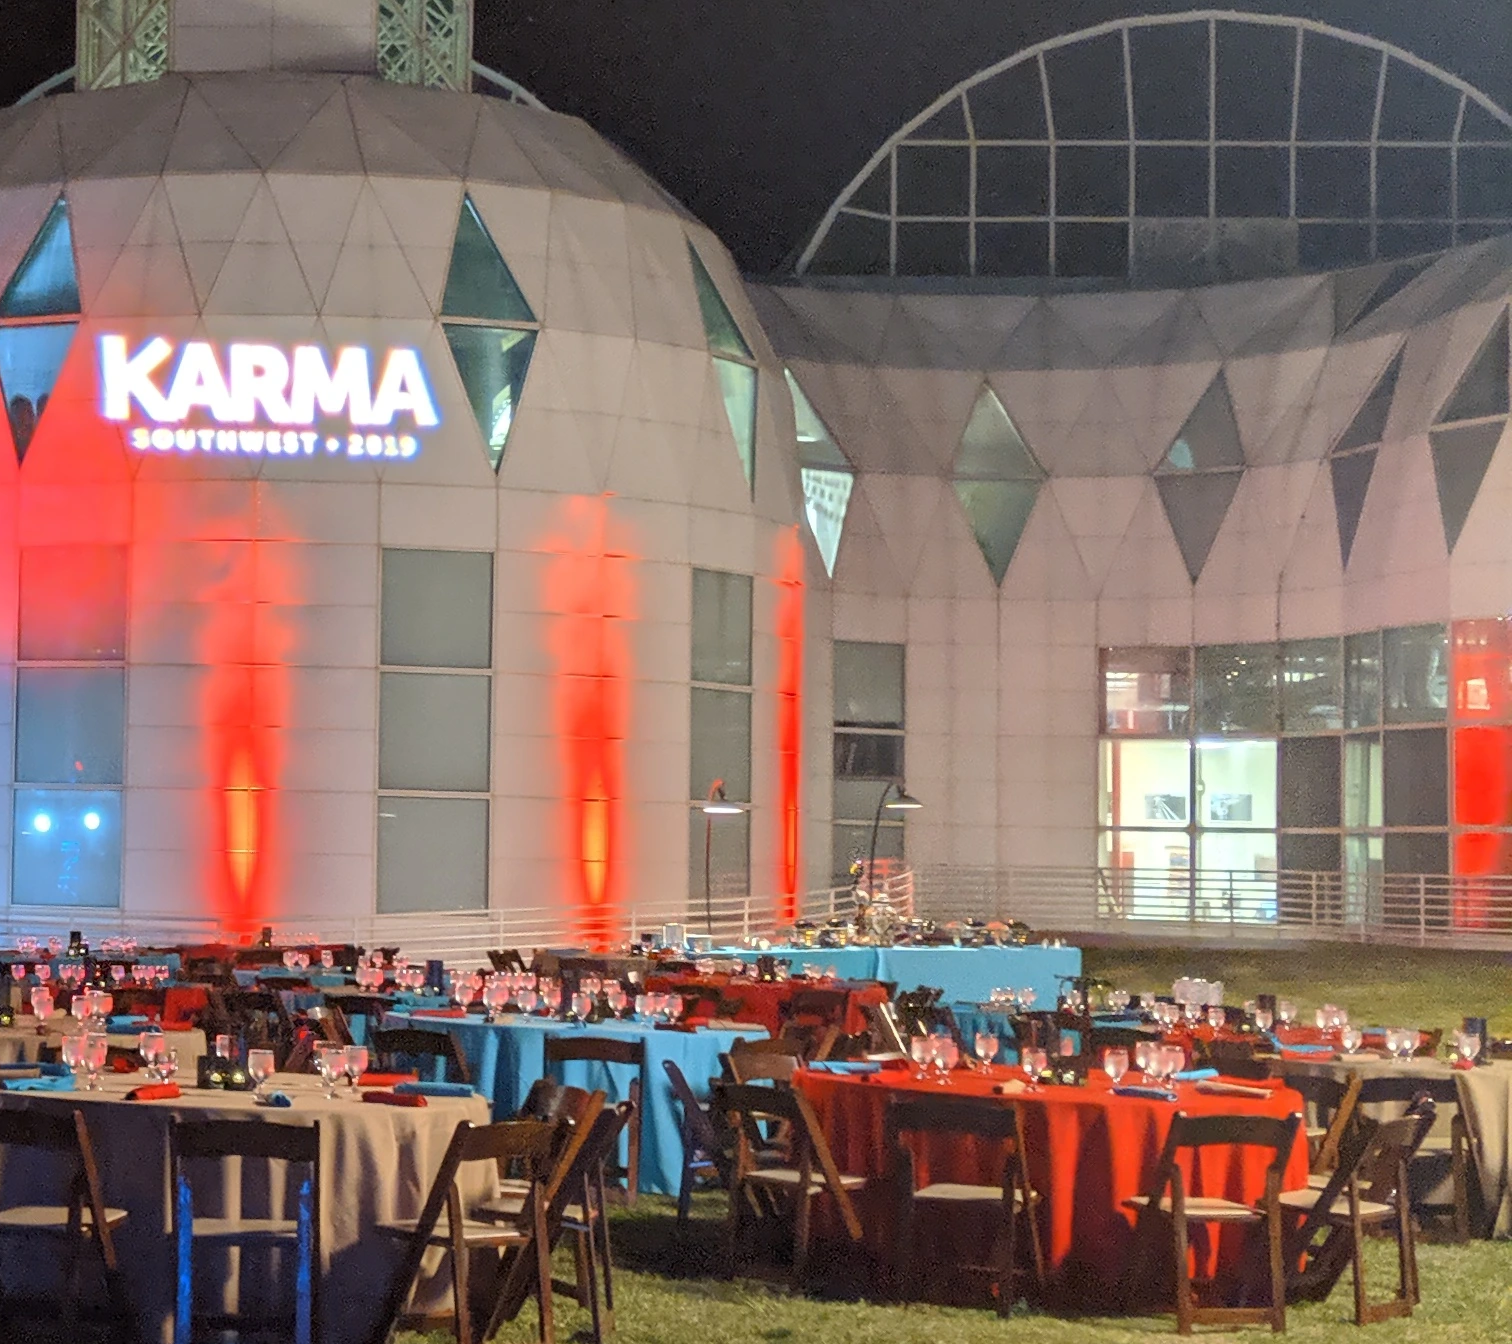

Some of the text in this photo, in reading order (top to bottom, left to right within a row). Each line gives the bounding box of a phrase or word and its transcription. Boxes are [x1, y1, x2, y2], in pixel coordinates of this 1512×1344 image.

[99, 333, 441, 427] KARMA
[132, 428, 419, 458] SOUTHWEST 2019
